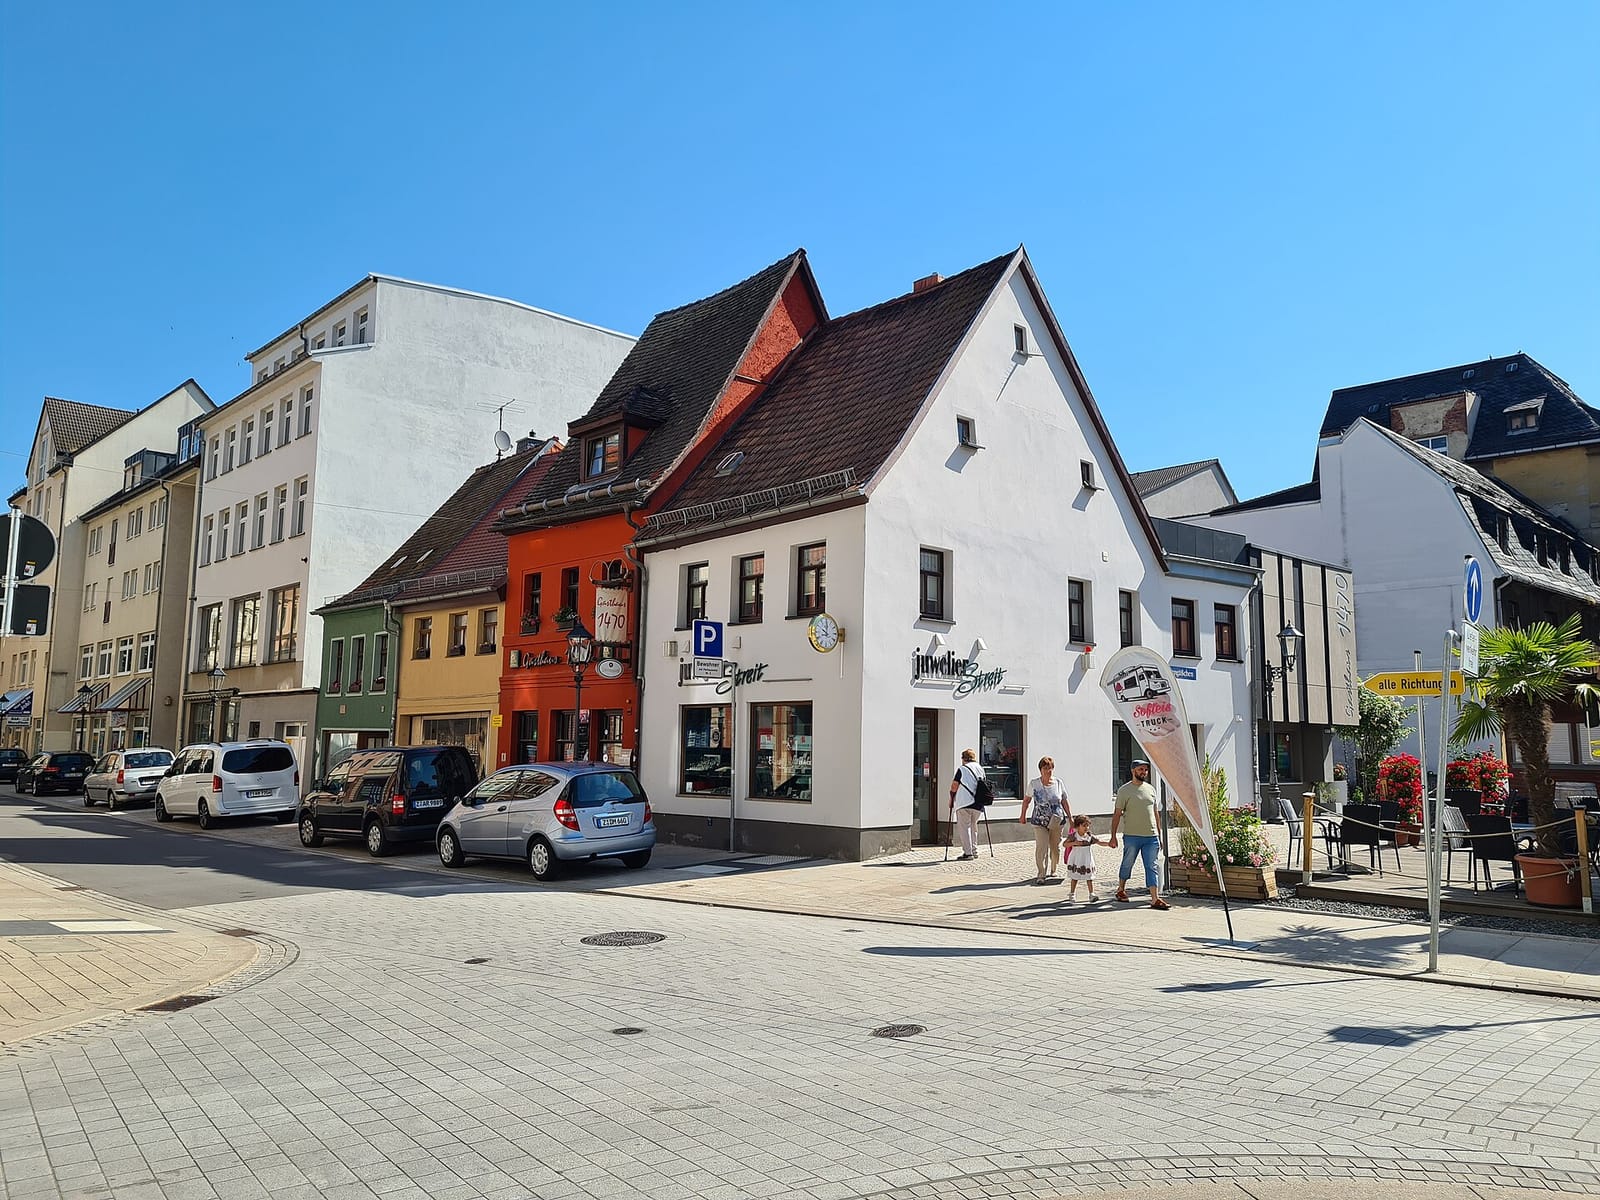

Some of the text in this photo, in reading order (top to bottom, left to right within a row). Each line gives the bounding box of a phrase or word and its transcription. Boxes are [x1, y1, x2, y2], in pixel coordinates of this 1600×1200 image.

[597, 596, 626, 608] Gasthaus
[1335, 573, 1351, 637] 1470
[597, 611, 625, 629] 1470
[700, 624, 717, 652] P
[522, 650, 559, 669] Gasthaus
[914, 646, 969, 680] juwelier
[958, 662, 1007, 693] Streit
[1378, 678, 1457, 691] alle Richtungn
[1133, 701, 1172, 718] Softeis
[1141, 716, 1168, 728] TRUCK
